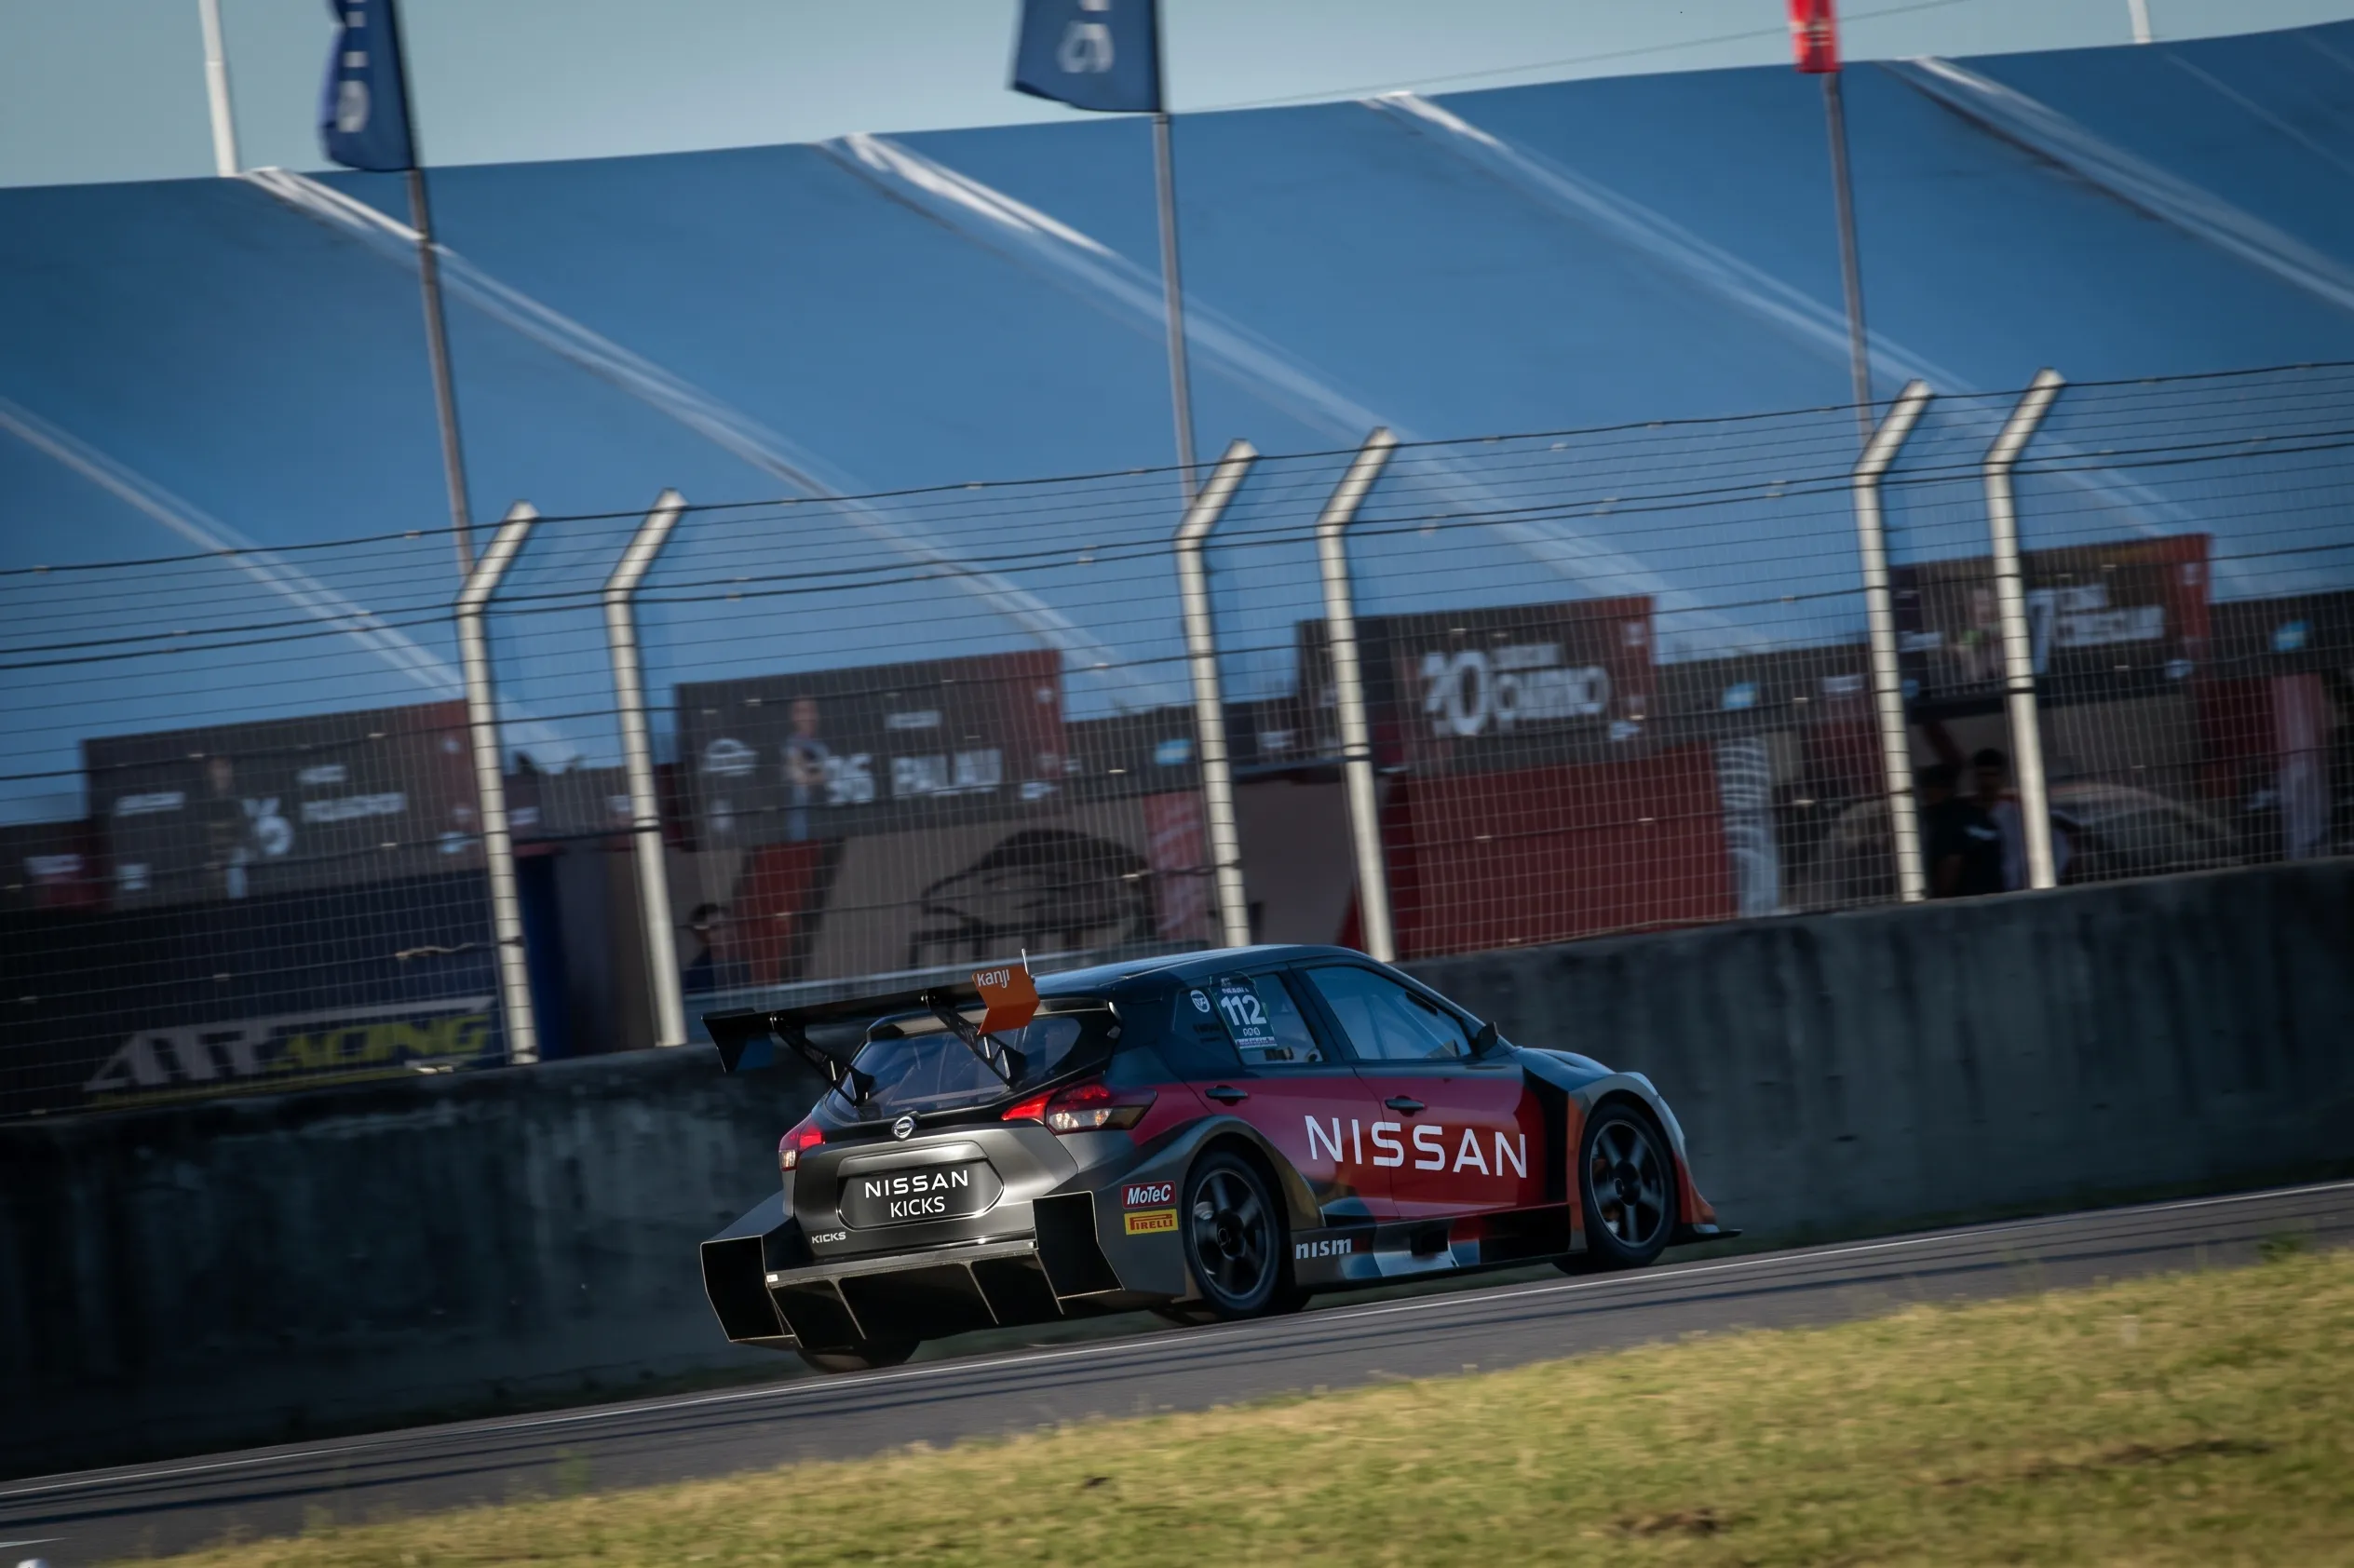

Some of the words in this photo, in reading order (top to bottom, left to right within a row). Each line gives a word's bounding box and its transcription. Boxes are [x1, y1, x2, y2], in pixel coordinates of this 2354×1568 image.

[976, 968, 1010, 989] kanji
[1221, 994, 1267, 1026] 112
[1304, 1115, 1528, 1179] NISSAN
[864, 1169, 969, 1198] NISSAN
[1127, 1183, 1171, 1205] MoTeC
[889, 1196, 946, 1218] KICKS
[1129, 1213, 1173, 1231] PIRELLI
[811, 1231, 846, 1244] KICKS
[1295, 1237, 1367, 1260] nism
